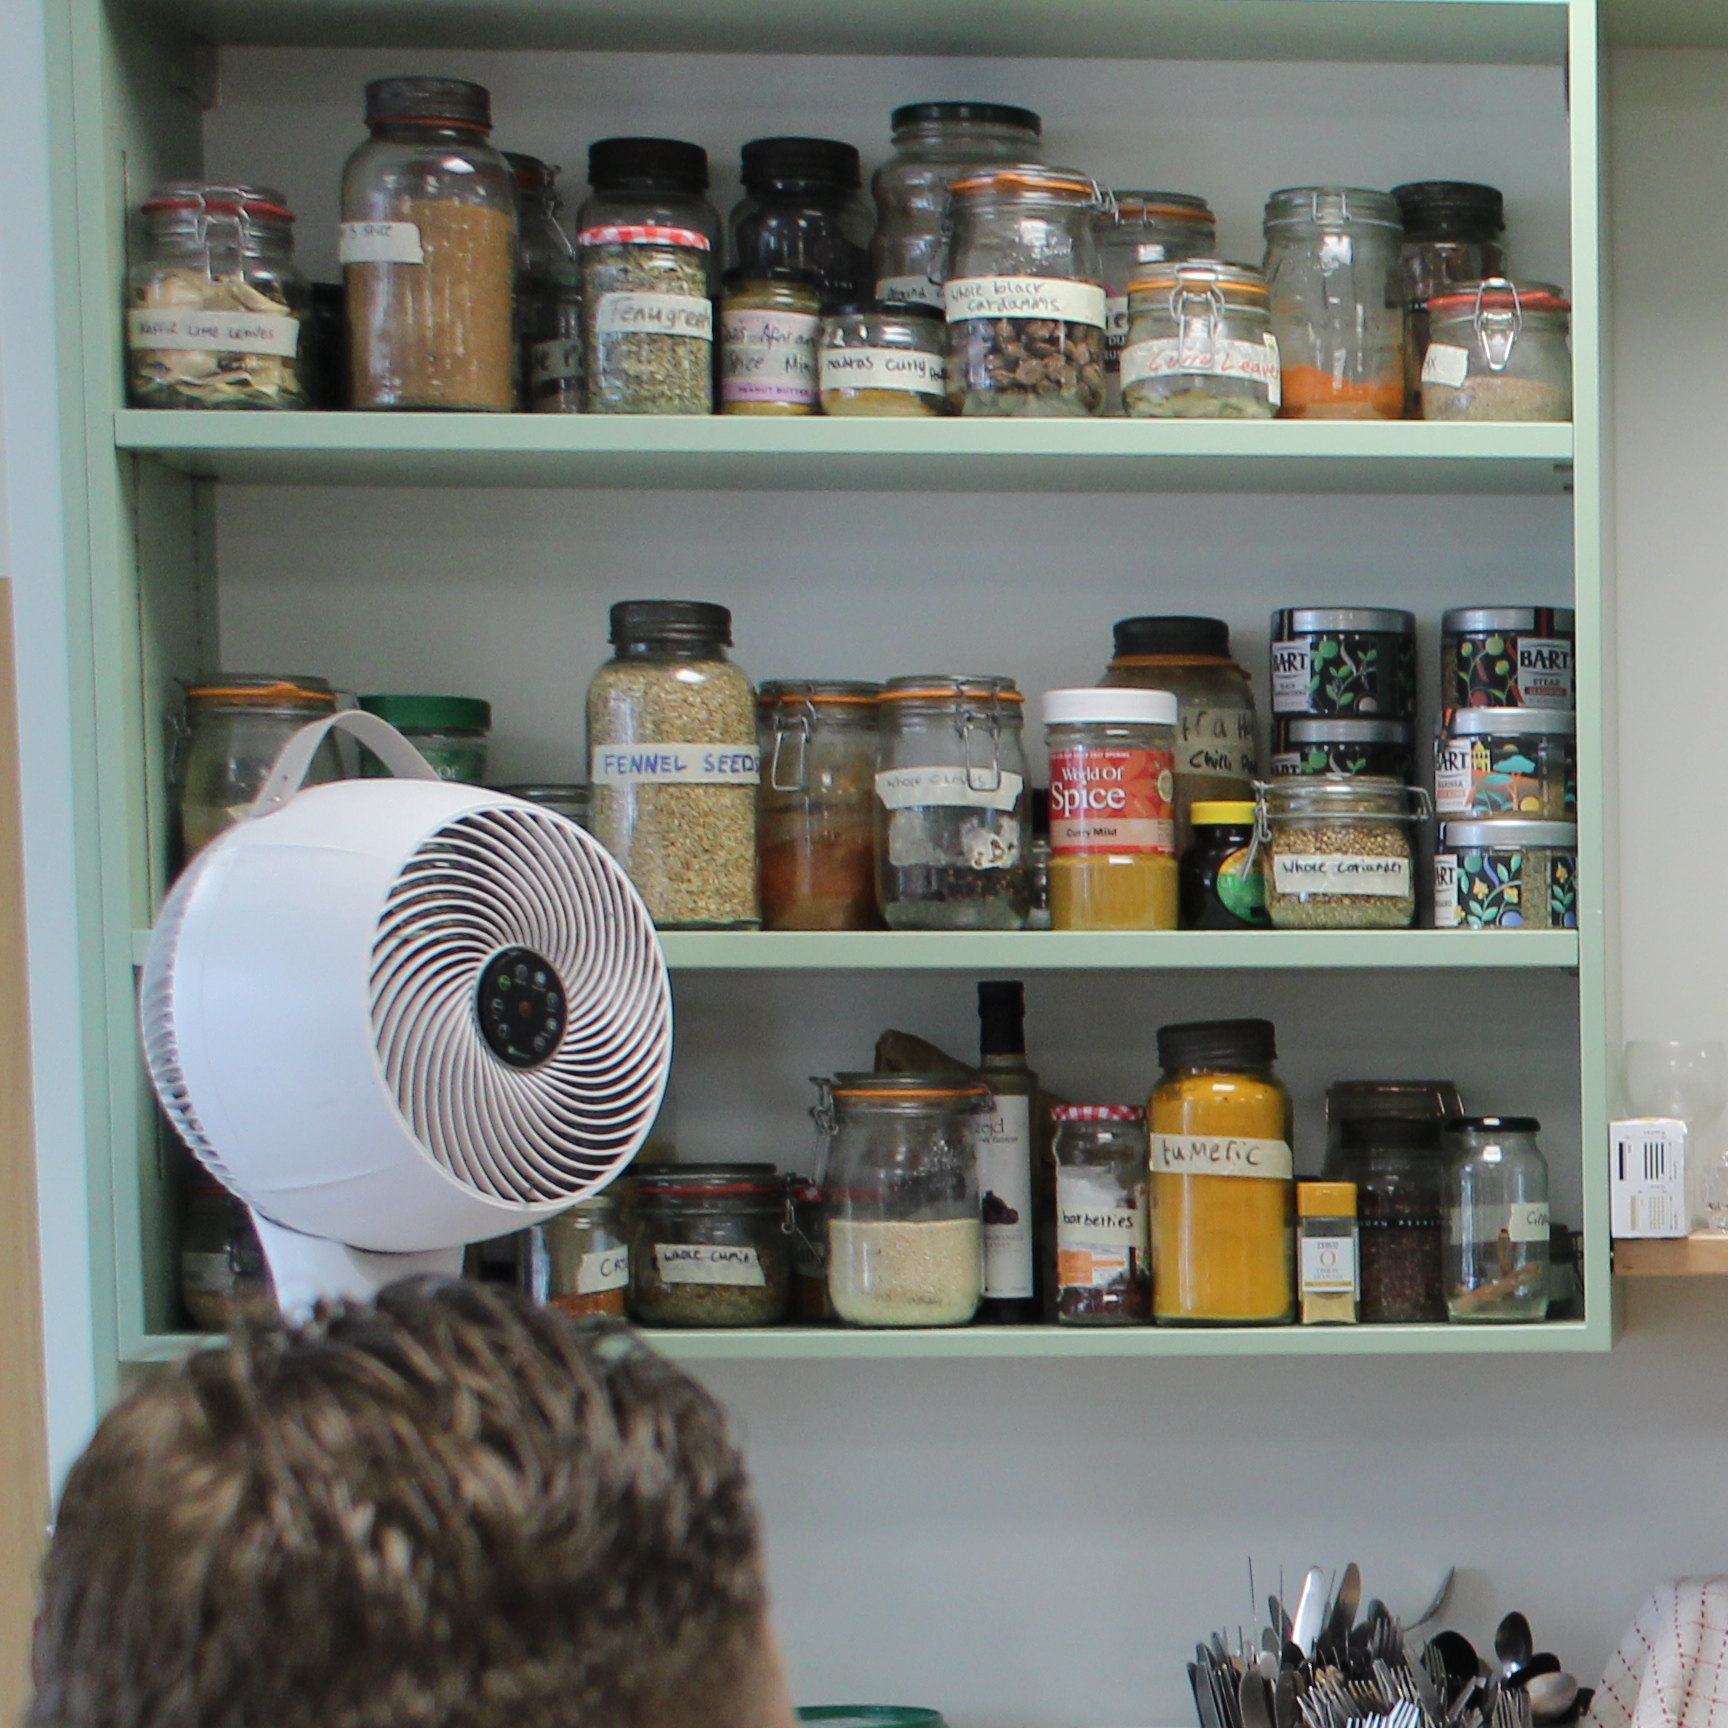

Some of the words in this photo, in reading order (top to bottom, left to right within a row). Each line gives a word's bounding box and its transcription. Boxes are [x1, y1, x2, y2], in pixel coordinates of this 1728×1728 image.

[1520, 649, 1571, 671] BART
[602, 751, 688, 775] FENNEL
[1062, 766, 1100, 784] World
[1103, 766, 1126, 782] Of
[1051, 784, 1126, 818] Spice
[1066, 828, 1090, 840] Curry
[1092, 827, 1118, 838] Mild
[1434, 866, 1456, 886] ART
